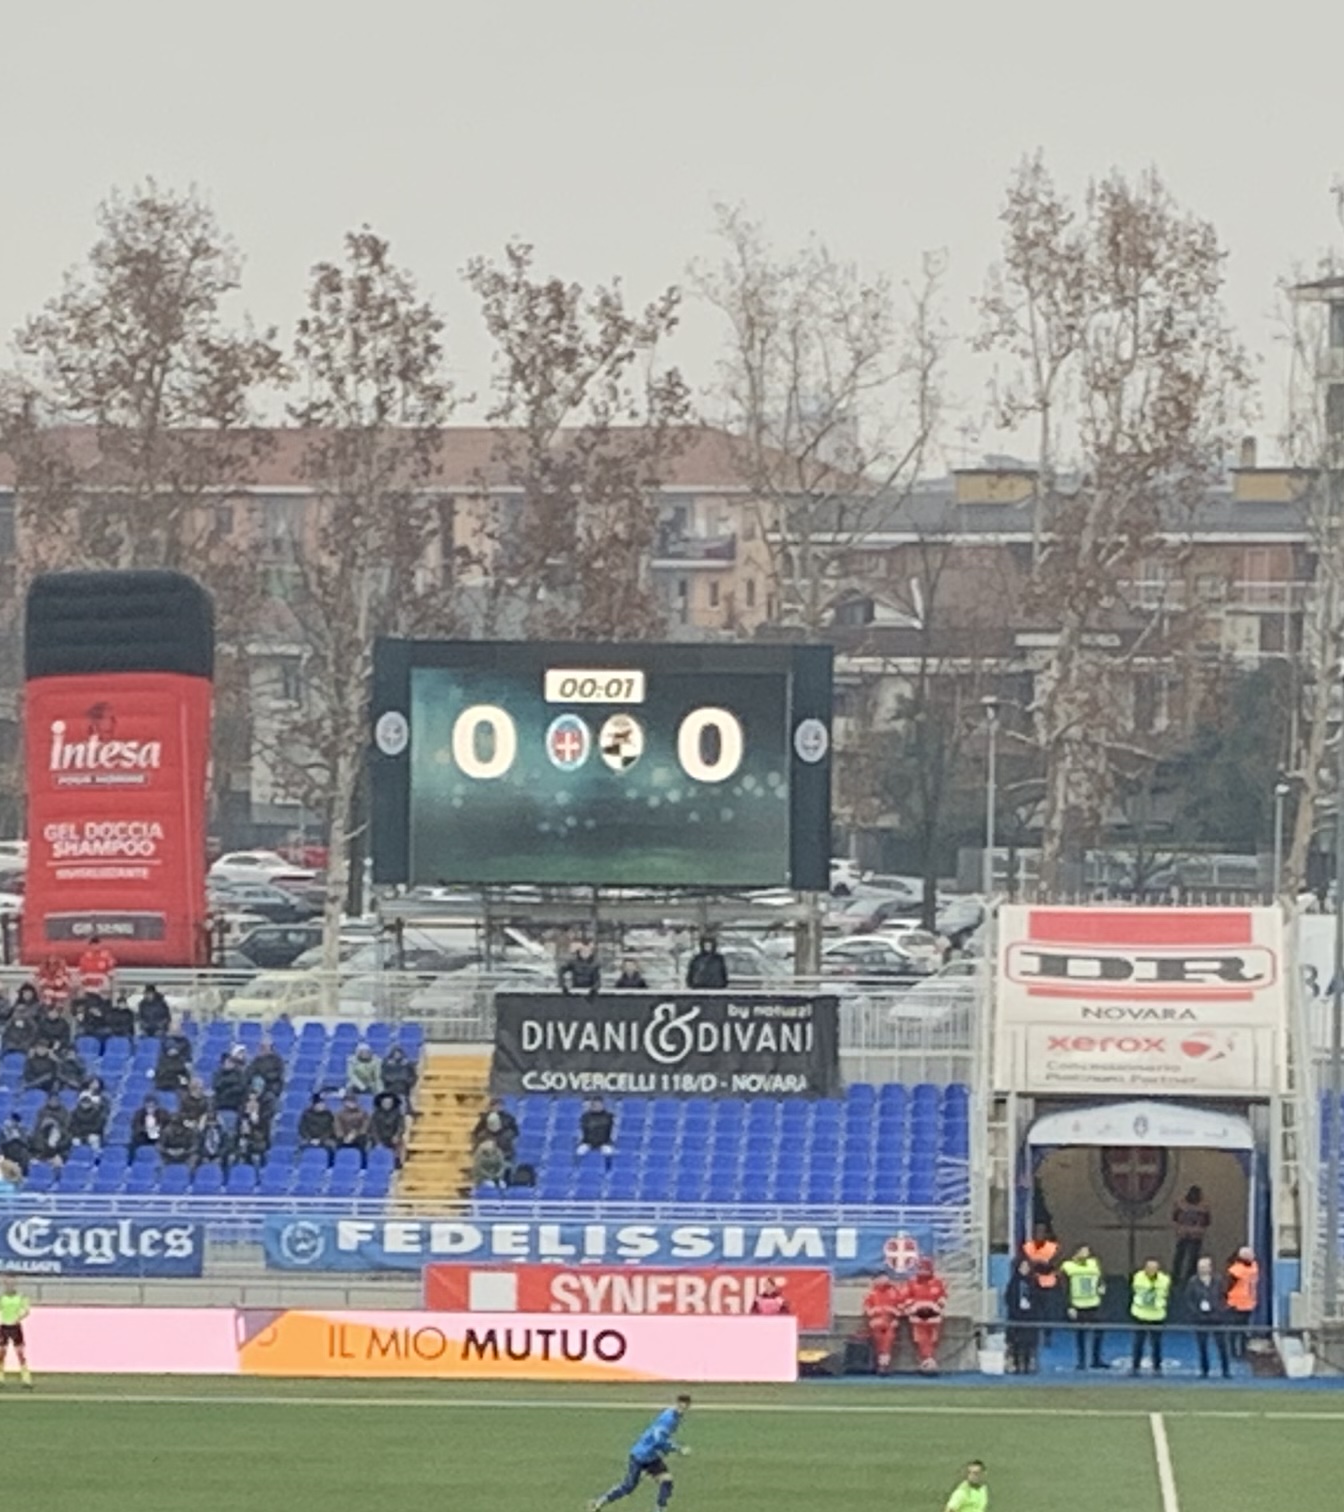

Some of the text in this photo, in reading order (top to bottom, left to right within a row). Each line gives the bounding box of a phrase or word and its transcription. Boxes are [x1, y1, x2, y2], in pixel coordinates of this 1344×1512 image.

[559, 678, 634, 698] 00:01
[452, 705, 516, 778] 0
[677, 707, 743, 781] 0
[44, 822, 164, 841] GEL DOCCIA
[53, 840, 156, 858] SHAMPOO
[1020, 952, 1264, 982] DR
[728, 1003, 749, 1019] by
[1081, 1006, 1197, 1020] NOVARA
[522, 1003, 813, 1063] DIVANI & DIVANI
[1046, 1035, 1166, 1053] xerox
[568, 1071, 655, 1091] VERCELLI
[661, 1074, 717, 1091] 118/D
[731, 1074, 807, 1092] NOVARA
[7, 1216, 195, 1264] Eagles
[337, 1221, 856, 1258] FEDELISSIMI
[328, 1325, 627, 1362] IL MIO MUTUO
